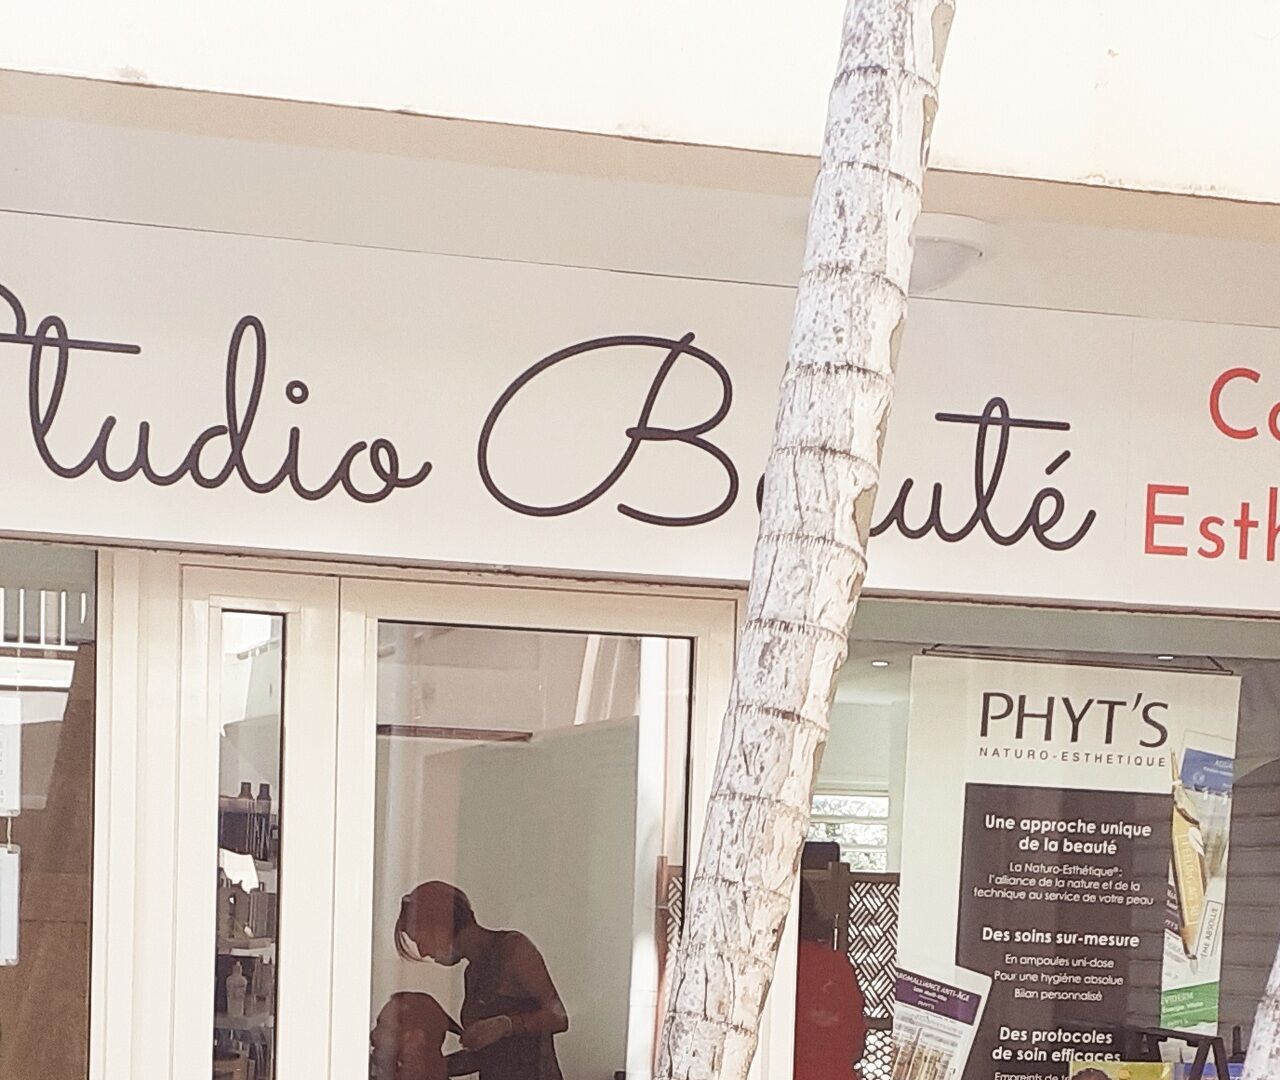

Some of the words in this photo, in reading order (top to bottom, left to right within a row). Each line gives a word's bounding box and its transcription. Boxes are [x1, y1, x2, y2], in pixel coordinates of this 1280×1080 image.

[477, 332, 1096, 552] Buté
[979, 692, 1169, 748] PHYT'S
[979, 747, 1166, 767] NATURO-ESTHETIQUE
[985, 814, 1015, 830] Une
[1020, 819, 1097, 834] approche
[1101, 820, 1152, 839] unique
[1019, 836, 1039, 851] de
[1044, 837, 1059, 852] la
[1062, 838, 1118, 855] beauté
[1009, 862, 1022, 873] La
[1039, 877, 1053, 887] de
[1055, 878, 1065, 888] la
[1067, 879, 1100, 889] nature
[1102, 880, 1113, 890] et
[1114, 881, 1128, 891] de
[1131, 881, 1141, 891] la
[974, 887, 1026, 900] technique
[1029, 891, 1042, 900] au
[1044, 891, 1080, 902] service
[1082, 893, 1096, 903] de
[1099, 894, 1124, 904] votre
[1126, 896, 1154, 906] peau
[982, 926, 1010, 942] Des
[1014, 928, 1052, 944] soins
[1055, 932, 1141, 948] sur-mesure
[1004, 953, 1018, 965] En
[1020, 955, 1070, 968] ampoules
[1071, 957, 1115, 969] uni-dose
[994, 970, 1016, 982] Pour
[1019, 973, 1038, 983] une
[1041, 972, 1082, 986] hygiène
[1084, 974, 1124, 986] absolue
[1014, 988, 1039, 1000] Bilan
[1041, 989, 1103, 1002] personnalisé
[1000, 1026, 1027, 1042] Des
[1031, 1028, 1113, 1045] protocoles
[992, 1046, 1013, 1061] de
[1016, 1047, 1047, 1062] soin
[1051, 1048, 1121, 1063] efficaces
